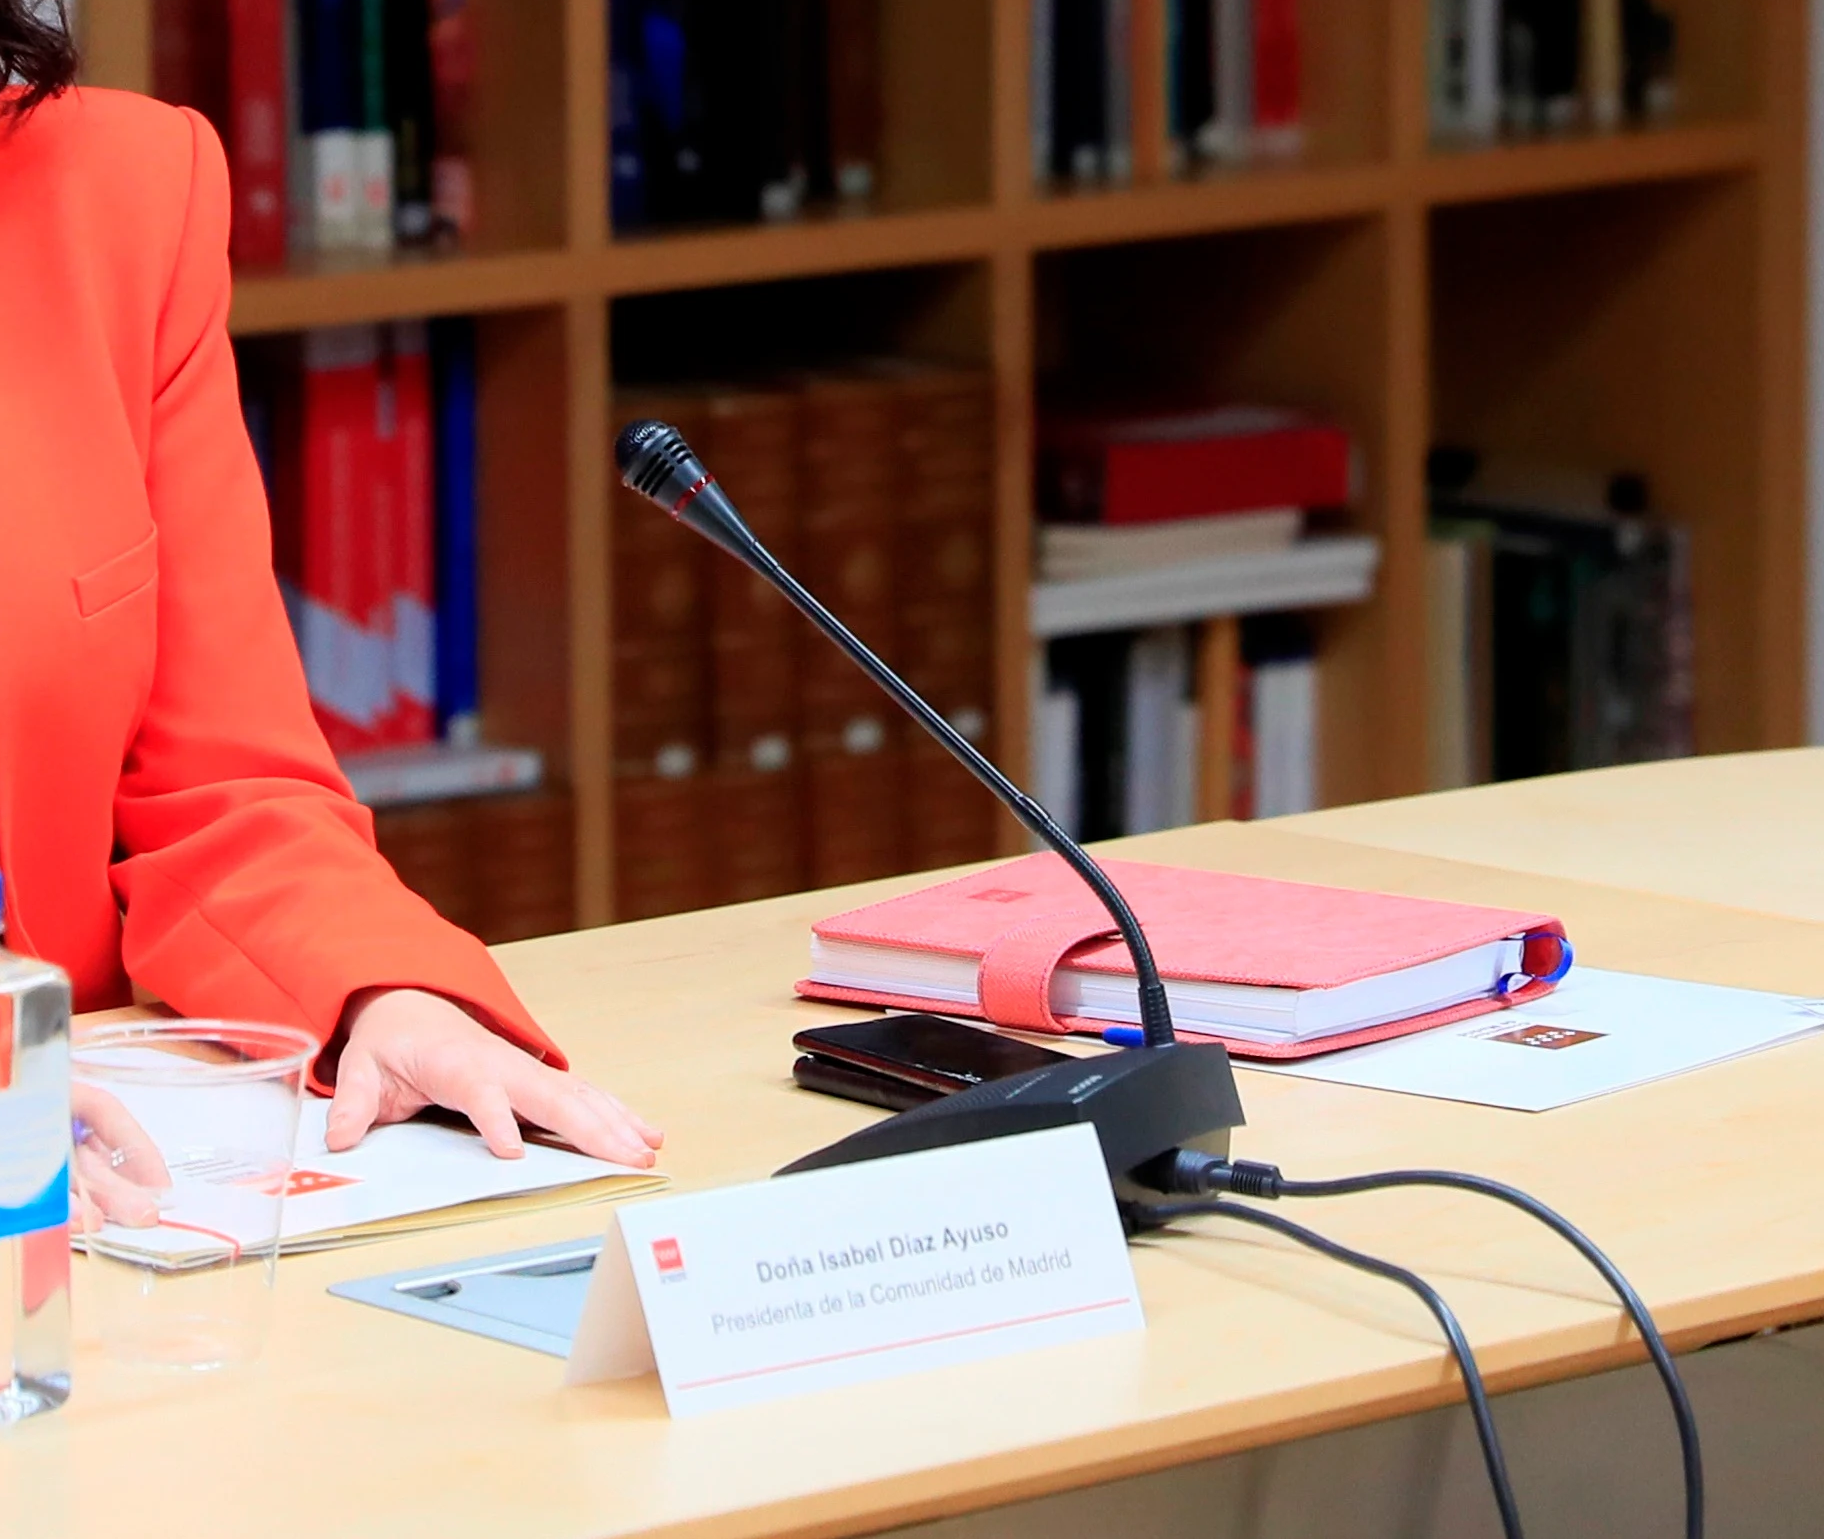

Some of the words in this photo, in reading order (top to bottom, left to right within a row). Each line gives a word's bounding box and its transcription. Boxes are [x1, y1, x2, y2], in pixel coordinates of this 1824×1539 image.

[756, 1257, 814, 1284] Doña
[818, 1239, 884, 1273] Isabel
[942, 1221, 1010, 1255] Ayuso
[711, 1298, 815, 1335] Presidenta
[819, 1293, 844, 1315] de
[848, 1289, 866, 1309] la
[869, 1268, 977, 1306] Comunidad
[981, 1262, 1005, 1285] de
[1009, 1248, 1073, 1280] Madrid
